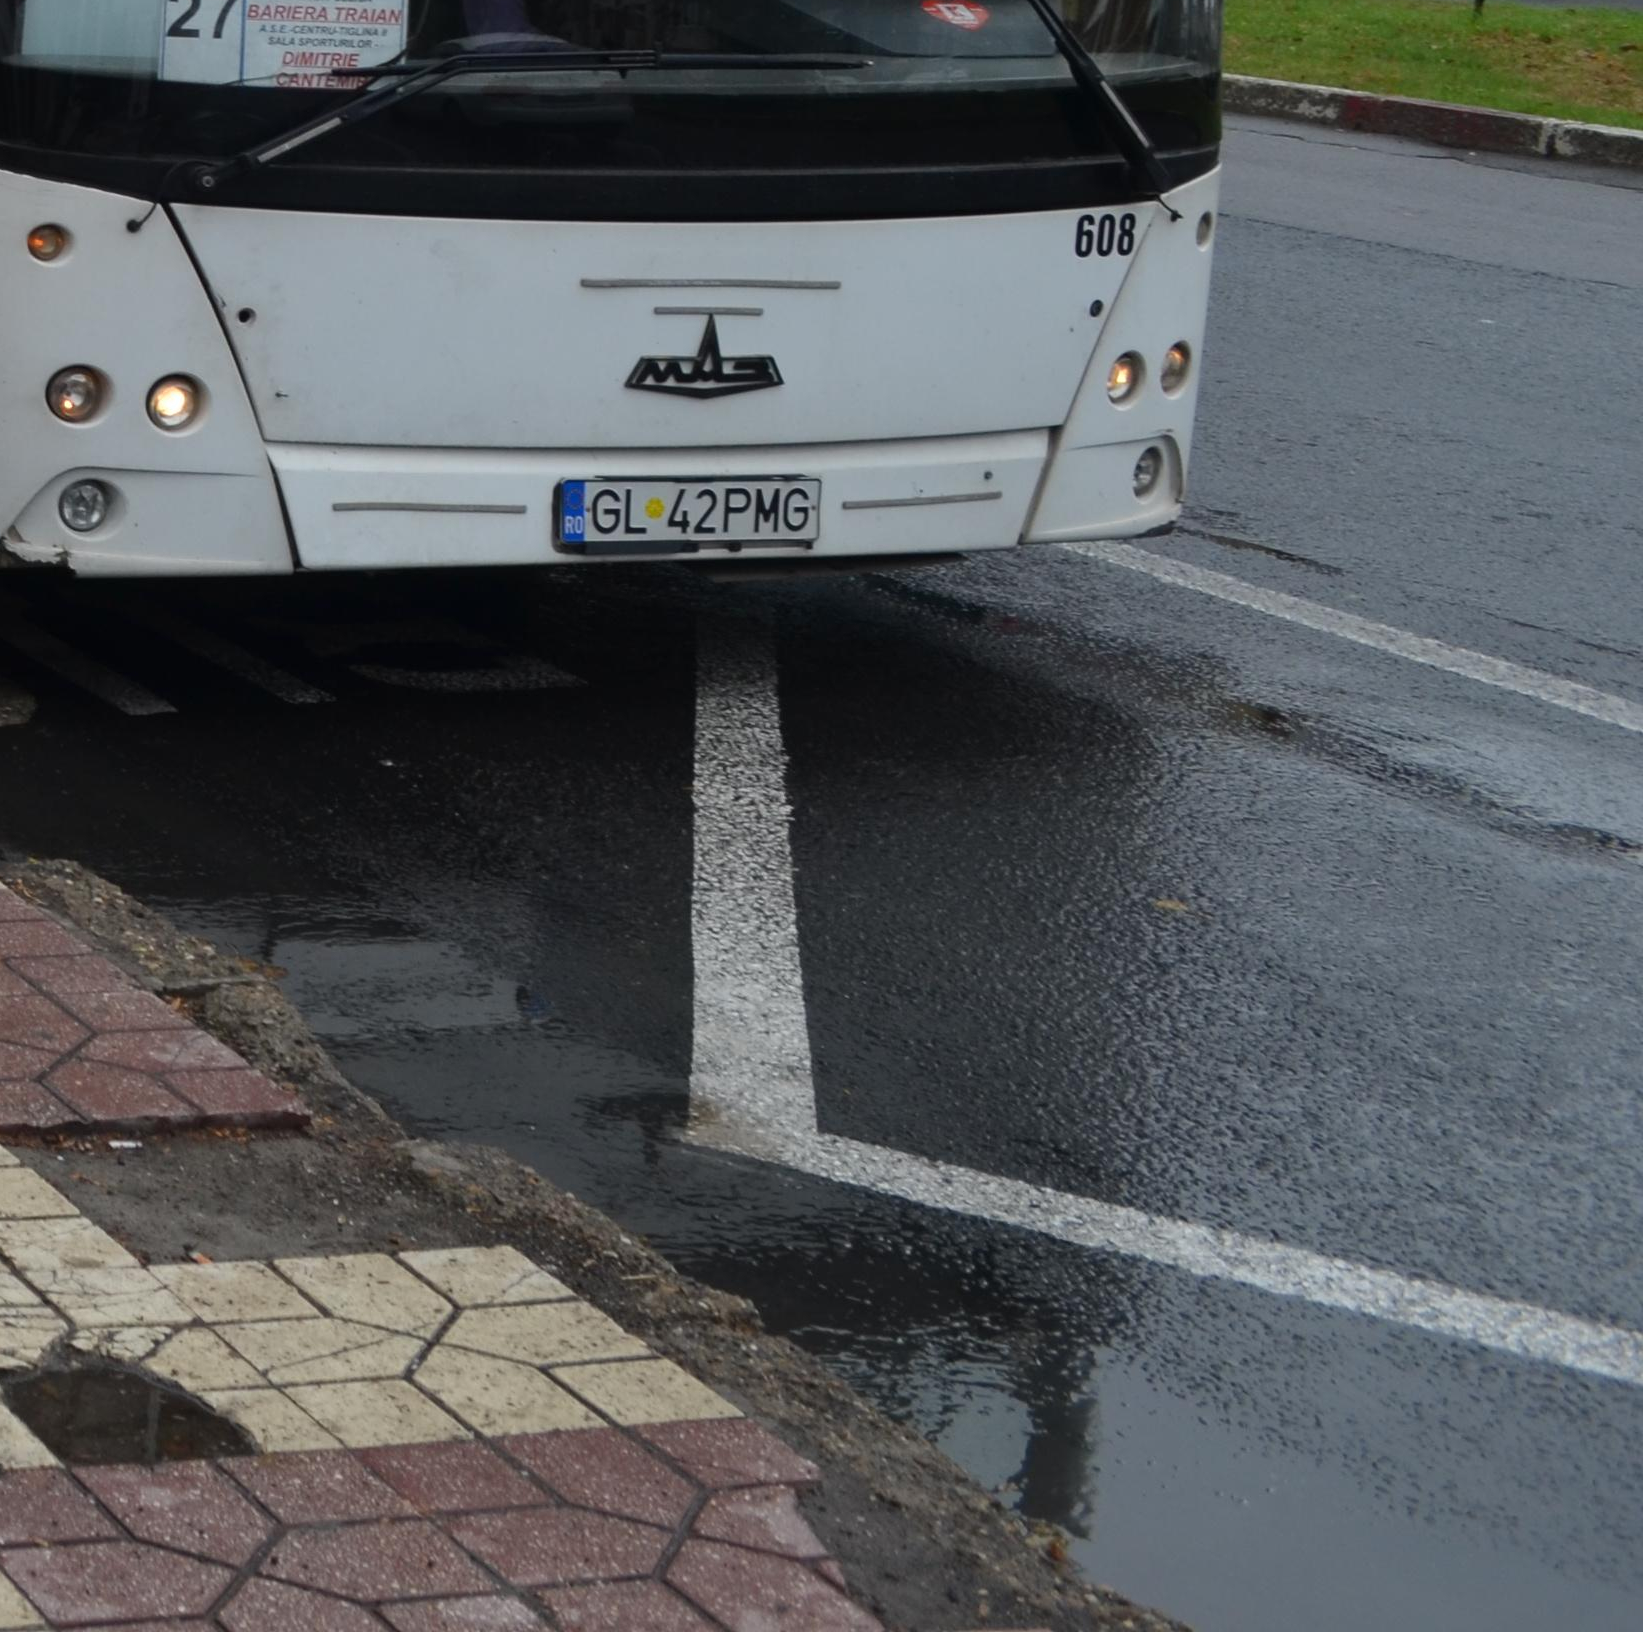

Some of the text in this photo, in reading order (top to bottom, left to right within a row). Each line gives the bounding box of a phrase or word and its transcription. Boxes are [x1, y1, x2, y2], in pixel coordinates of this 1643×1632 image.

[247, 4, 403, 24] BARIERA TRAIAN
[267, 36, 296, 47] SALA
[298, 37, 373, 49] SPORTURILOR
[282, 51, 360, 68] DIMITRIE
[1075, 213, 1136, 258] 608
[565, 515, 583, 535] RO
[592, 488, 647, 535] GL
